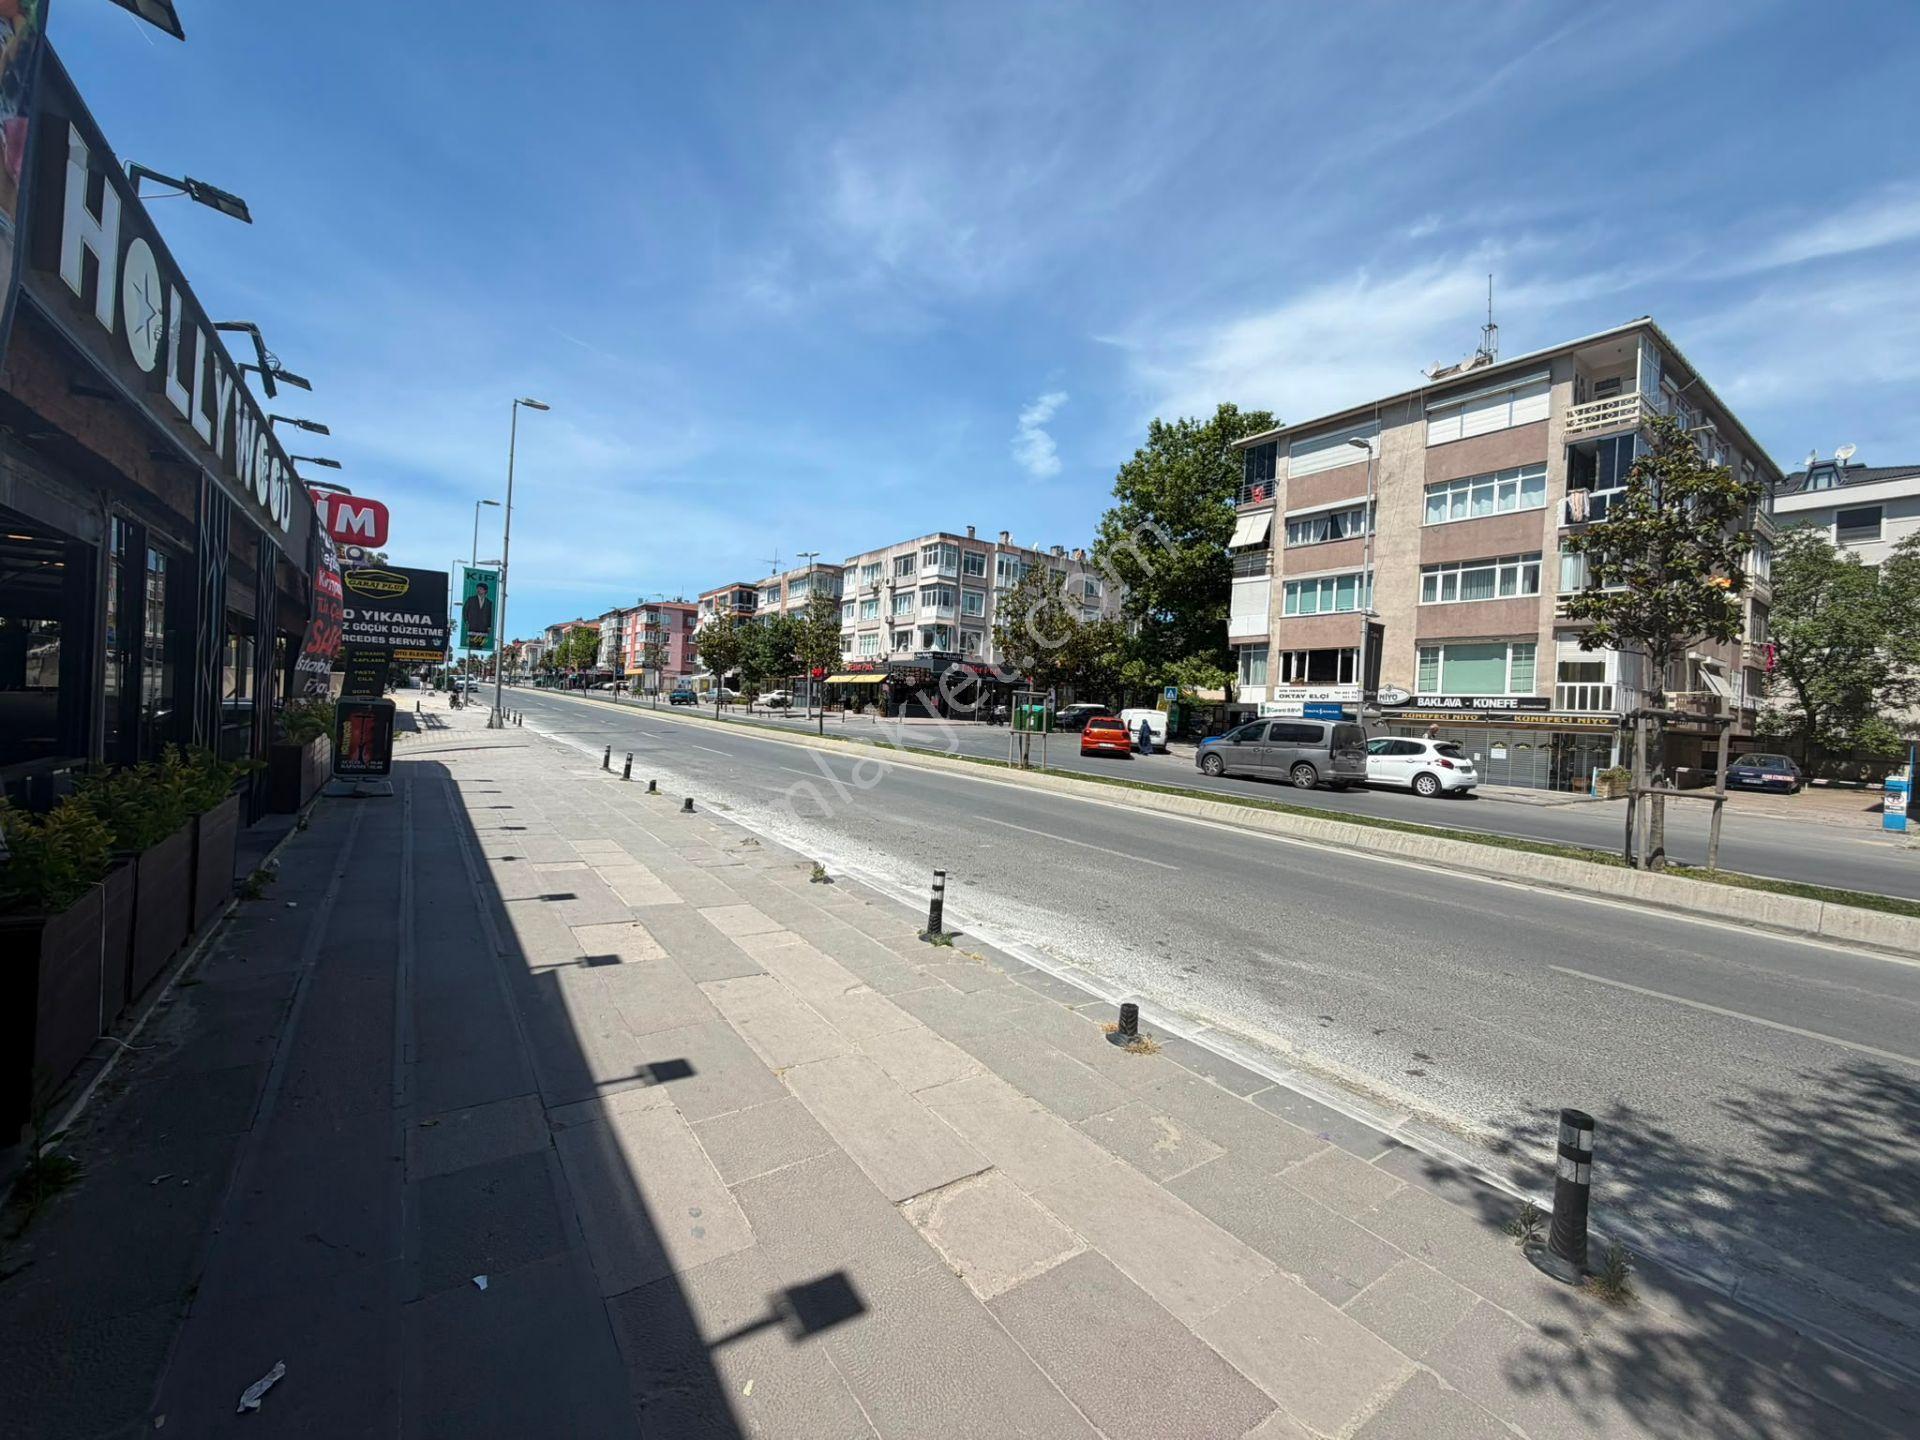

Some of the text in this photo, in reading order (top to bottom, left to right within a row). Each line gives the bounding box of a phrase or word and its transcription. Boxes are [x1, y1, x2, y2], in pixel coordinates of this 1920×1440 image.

[60, 120, 291, 533] HOLLYWOOD
[361, 610, 432, 625] YIKAMA
[352, 622, 389, 634] GÖÇÜK
[391, 625, 444, 637] DÜZELTME
[1417, 697, 1463, 708] BAKLAVA
